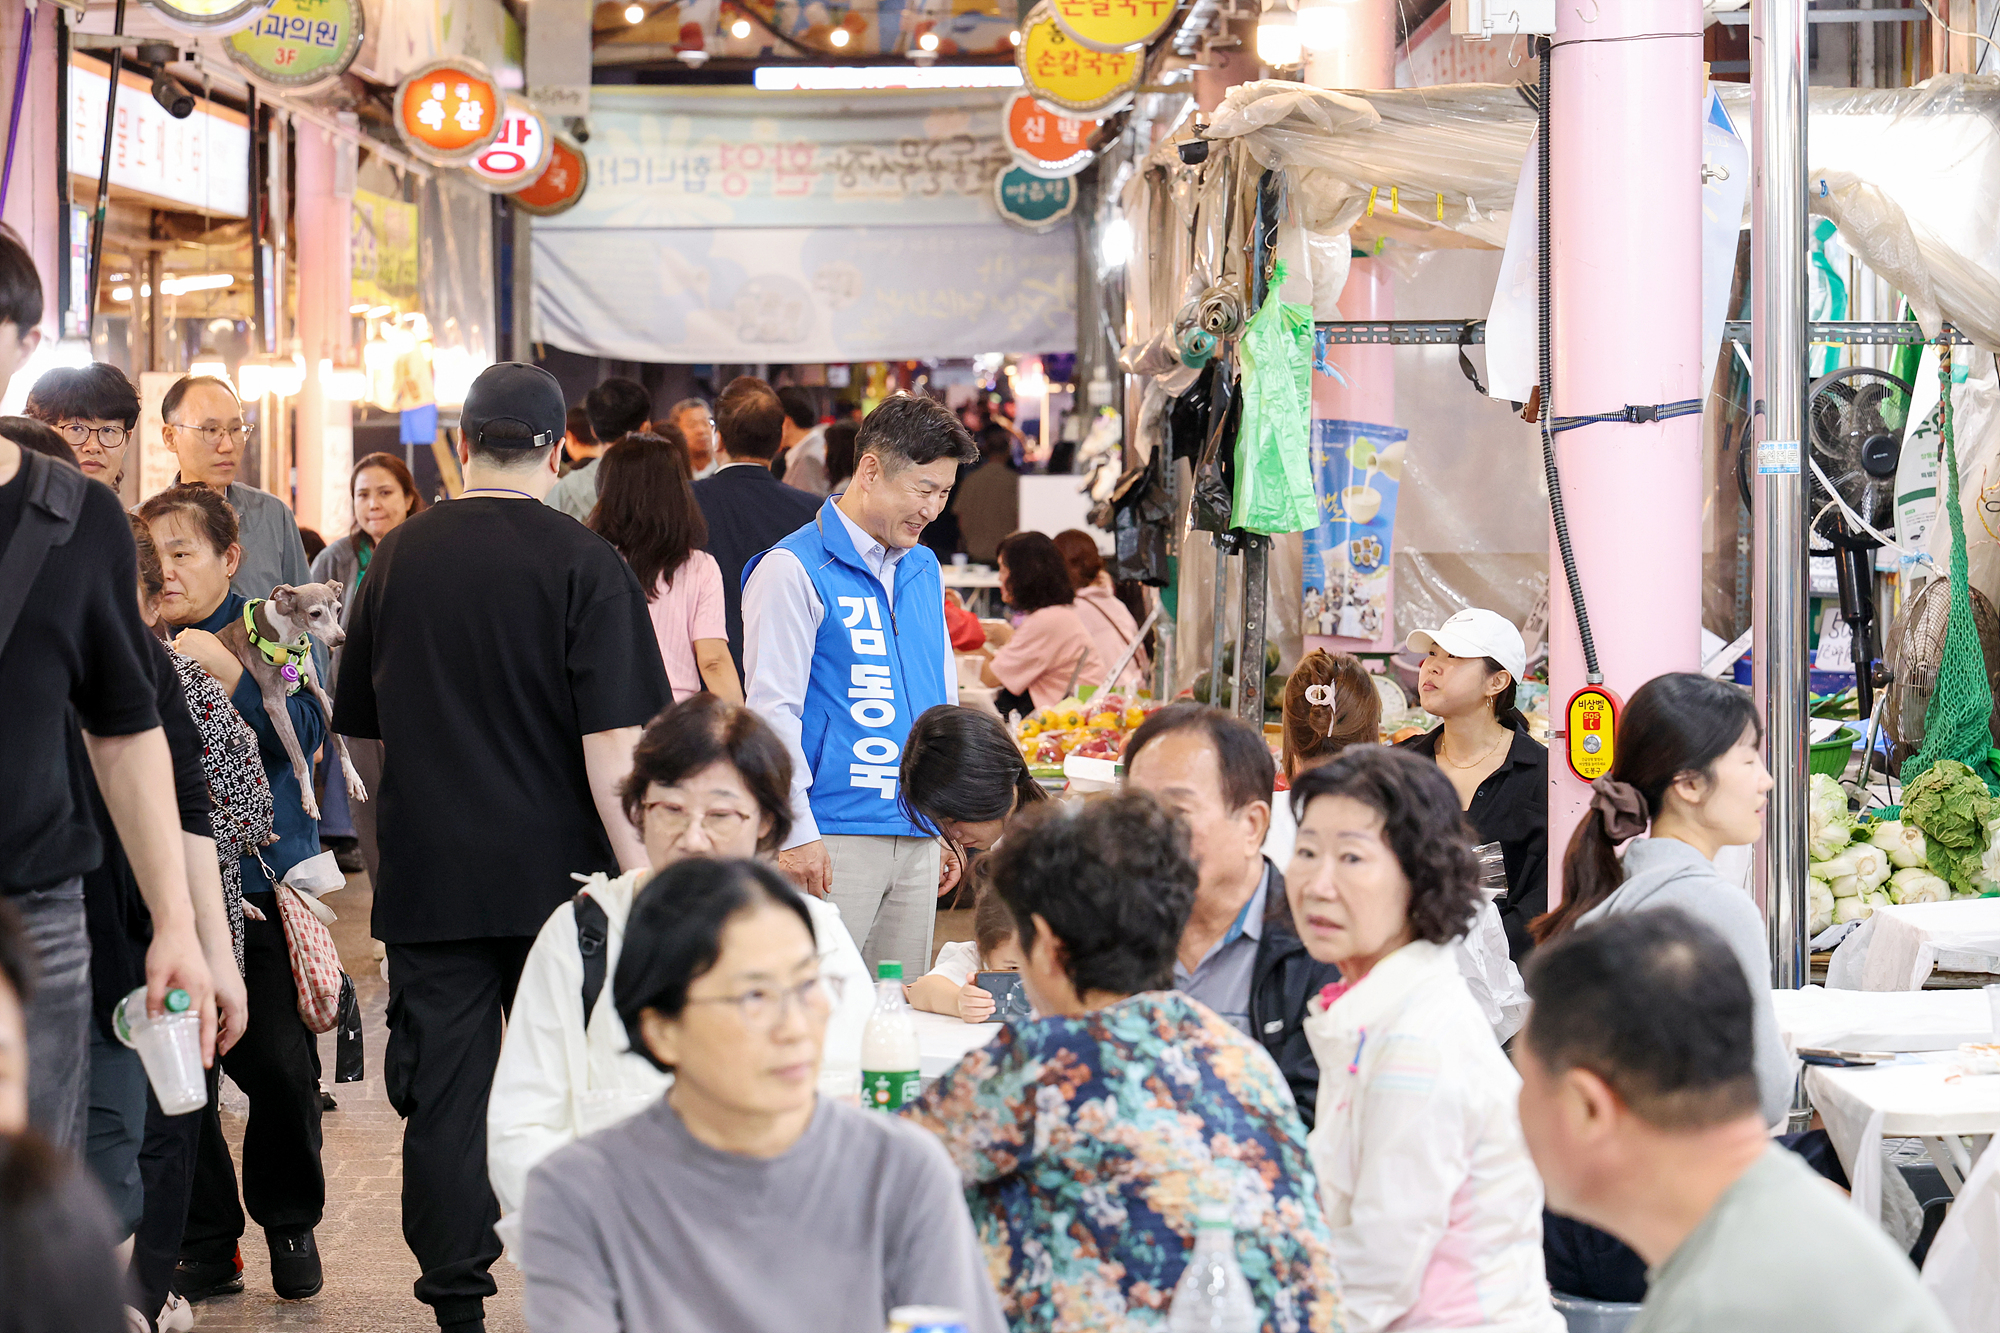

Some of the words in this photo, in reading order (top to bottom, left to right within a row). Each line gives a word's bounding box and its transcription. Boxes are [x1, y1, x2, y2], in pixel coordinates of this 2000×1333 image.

[274, 48, 297, 66] 3F
[1036, 49, 1127, 77] 손칼국수
[837, 596, 900, 801] 김동욱
[1578, 699, 1605, 711] 비상벨
[1584, 767, 1602, 775] 도봉구
